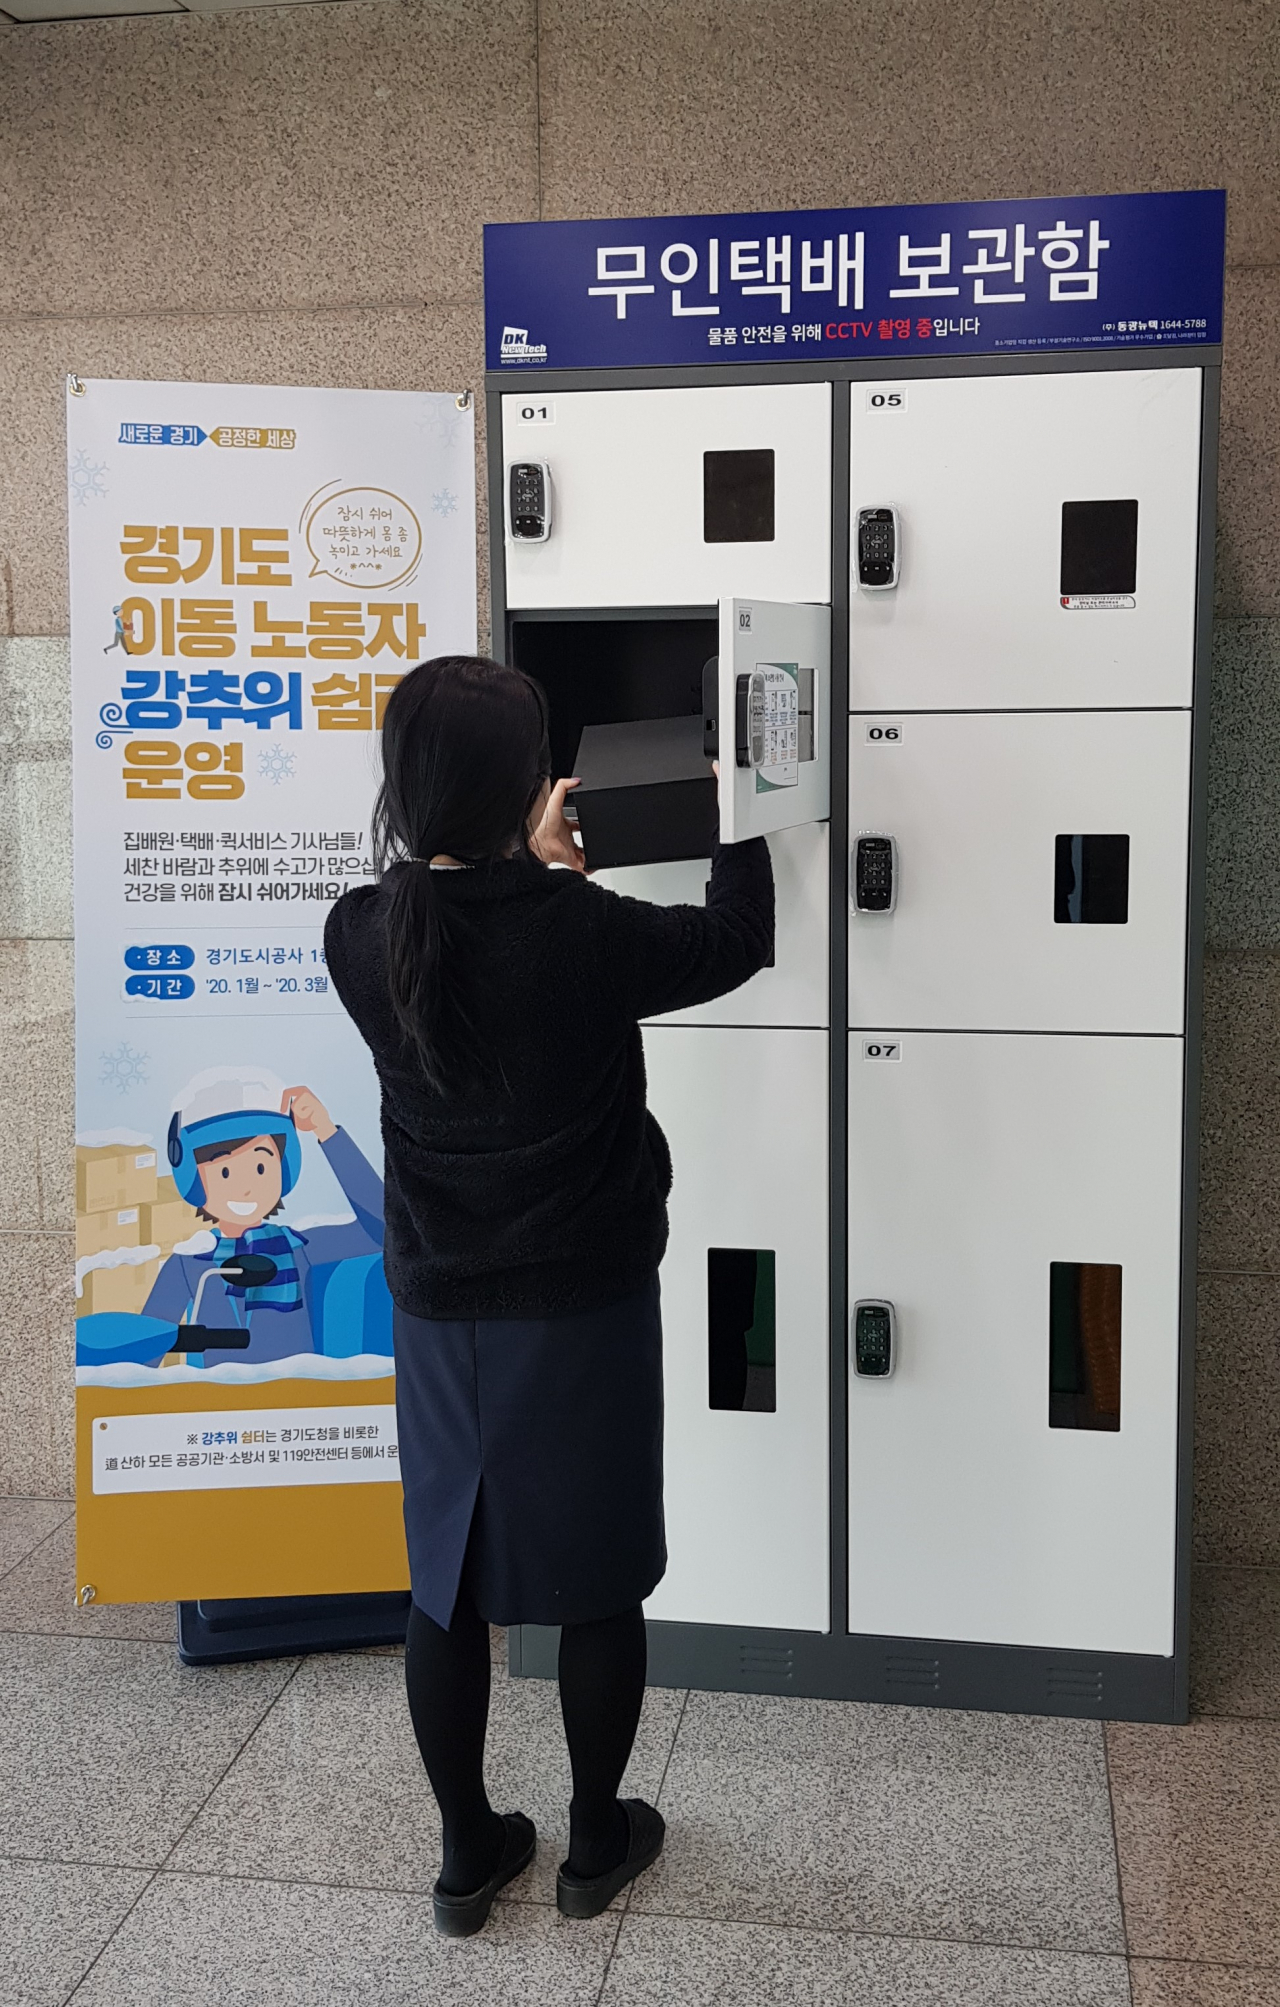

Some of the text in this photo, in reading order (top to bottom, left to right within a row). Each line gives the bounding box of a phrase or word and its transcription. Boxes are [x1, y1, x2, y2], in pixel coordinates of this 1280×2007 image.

[587, 219, 1110, 319] 무인택배 보관함
[707, 326, 738, 347] 물품
[741, 323, 787, 345] 안전을
[791, 321, 822, 343] 위해
[825, 319, 873, 340] CCTV
[877, 317, 912, 340] 촬영
[1160, 318, 1207, 329] 1644-5788
[504, 333, 525, 345] DK
[871, 394, 902, 406] 05
[521, 407, 548, 419] 01
[119, 424, 296, 449] 새로운 경기 공정한 세상
[337, 505, 393, 522] 잠시 쉬어
[322, 526, 408, 543] 따뜻하게 몸 좀
[119, 524, 293, 587] 경기도
[329, 544, 403, 559] 녹이고 가세요
[120, 596, 427, 660] 이동 노동자
[739, 613, 751, 628] 02
[120, 670, 302, 731] 강추위
[868, 727, 900, 740] 06
[122, 740, 246, 801] 운영
[291, 831, 363, 852] 기사님들!
[124, 857, 159, 877] 세찬
[163, 857, 215, 877] 바람과
[219, 857, 269, 876] 추위에
[274, 857, 324, 876] 수고가
[124, 883, 176, 903] 건강을
[180, 883, 214, 903] 위해
[218, 882, 252, 902] 잠시
[206, 947, 304, 965] 경기도시공사
[236, 977, 259, 995] 1월
[305, 976, 328, 994] 3월
[868, 1045, 896, 1056] 07
[202, 1431, 238, 1445] 강추위
[241, 1429, 277, 1444] 쉼터는
[281, 1426, 340, 1443] 경기도청을
[343, 1425, 379, 1440] 비롯한
[105, 1457, 119, 1471] 道
[121, 1455, 145, 1469] 산하
[148, 1453, 173, 1468] 모든
[268, 1448, 280, 1463] 및
[283, 1445, 348, 1462] 119안전센터
[351, 1445, 385, 1460] 등에서
